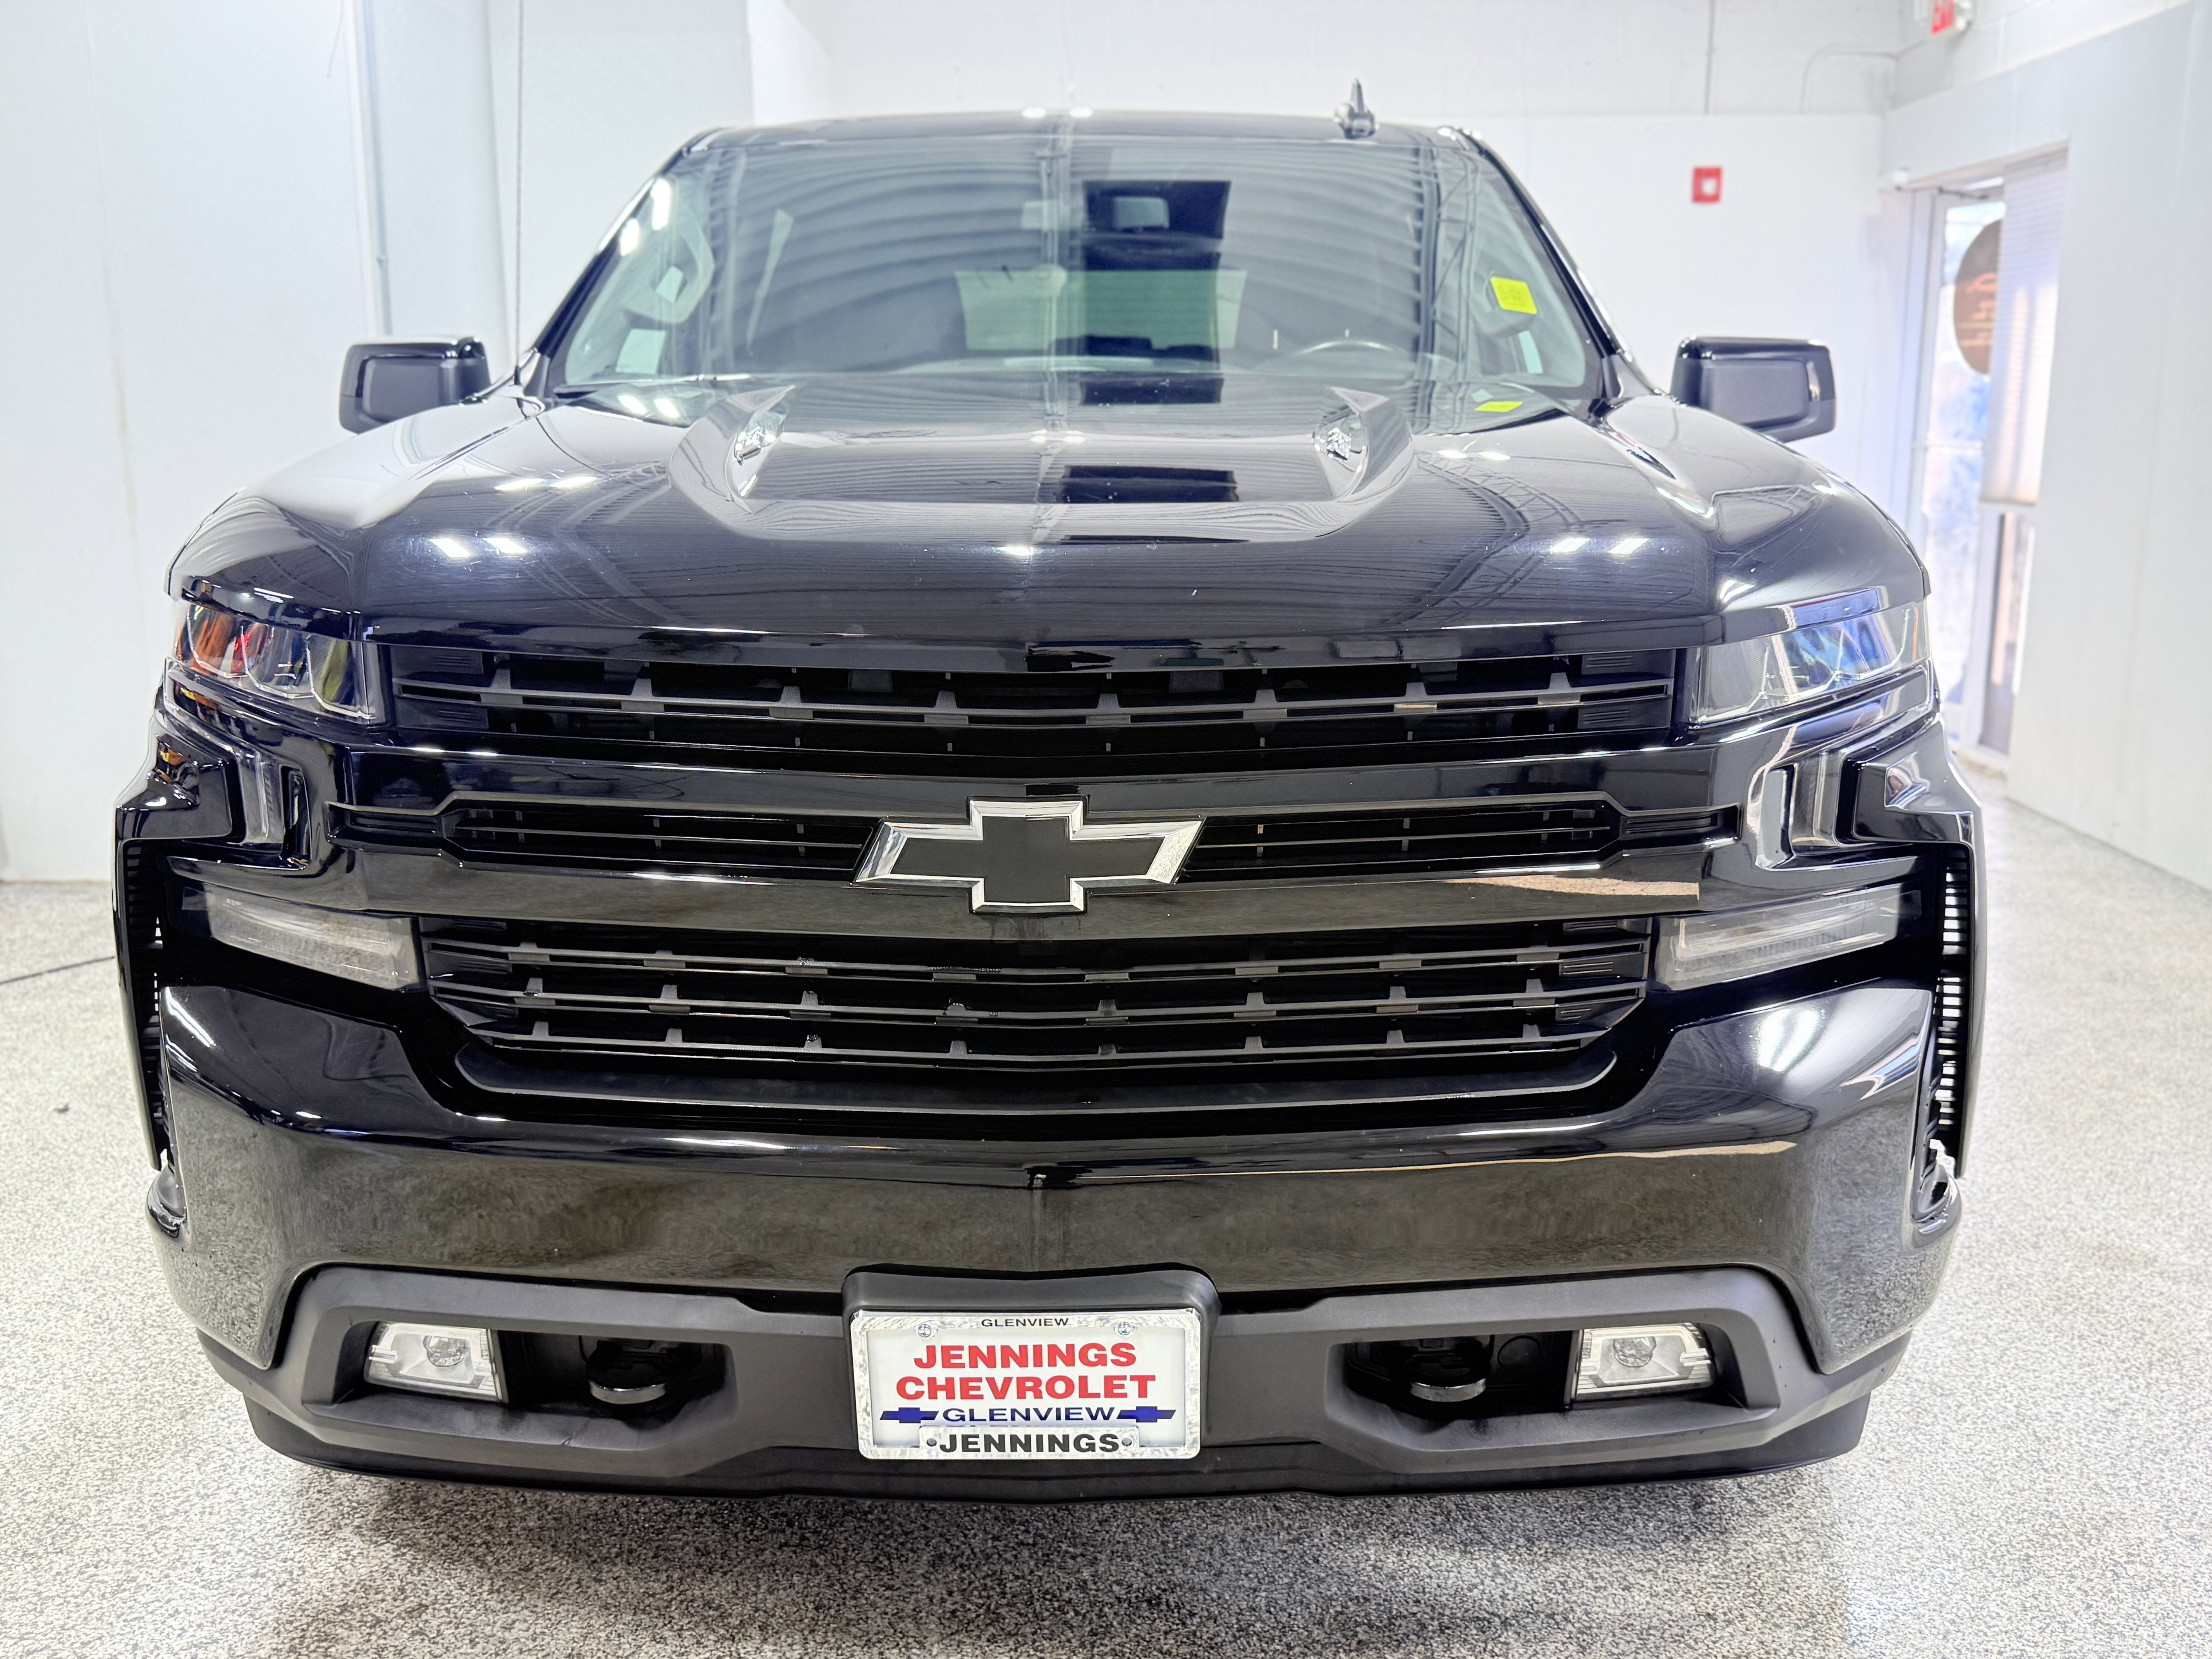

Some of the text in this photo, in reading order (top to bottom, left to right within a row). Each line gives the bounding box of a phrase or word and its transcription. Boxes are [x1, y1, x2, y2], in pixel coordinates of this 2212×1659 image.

[981, 1318, 1069, 1327] GLENVIEW
[914, 1343, 1136, 1369] JENNINGS
[896, 1375, 1156, 1400] CHEVROLET
[943, 1407, 1115, 1422] GLENVIEW
[939, 1434, 1119, 1453] JENNINGS
